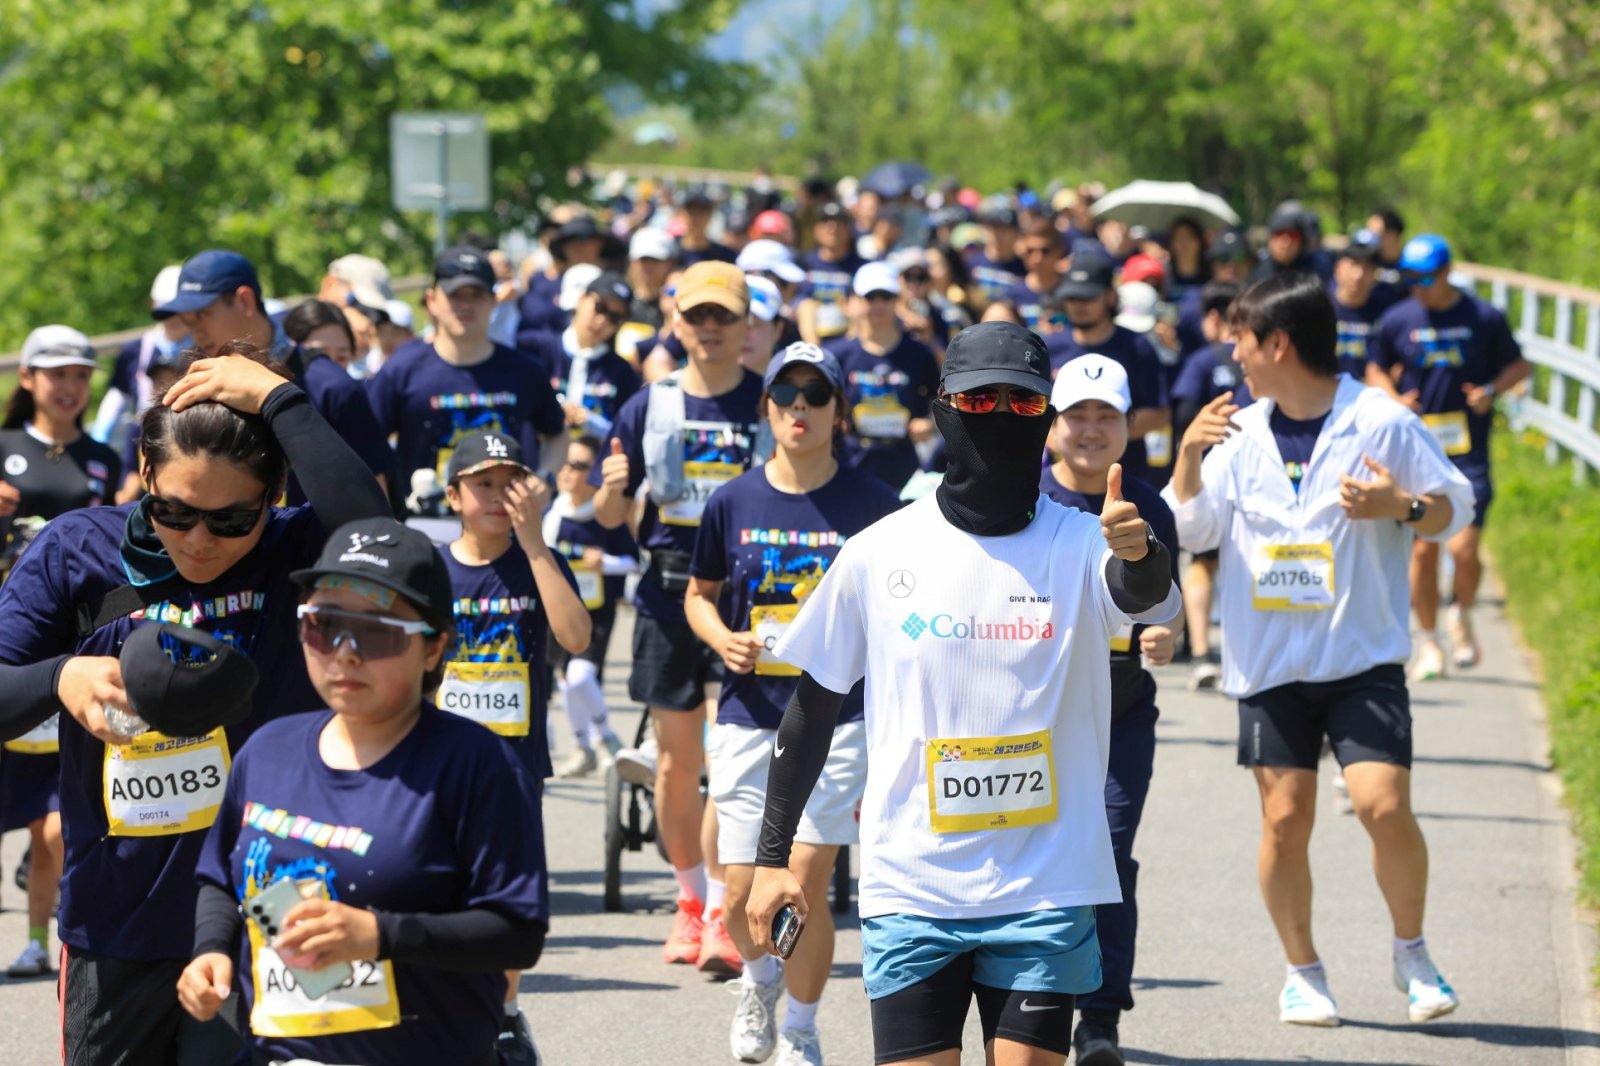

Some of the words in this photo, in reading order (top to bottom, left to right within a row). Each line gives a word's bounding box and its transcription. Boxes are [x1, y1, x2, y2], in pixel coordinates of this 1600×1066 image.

[484, 435, 508, 457] LA
[1009, 595, 1027, 603] GIVE
[1037, 595, 1052, 603] RAC
[929, 613, 1054, 641] Columbia
[444, 691, 520, 710] C01184
[111, 764, 222, 801] A00183
[943, 770, 1045, 799] D01772
[138, 810, 169, 821] D00174
[267, 960, 380, 993] A02
